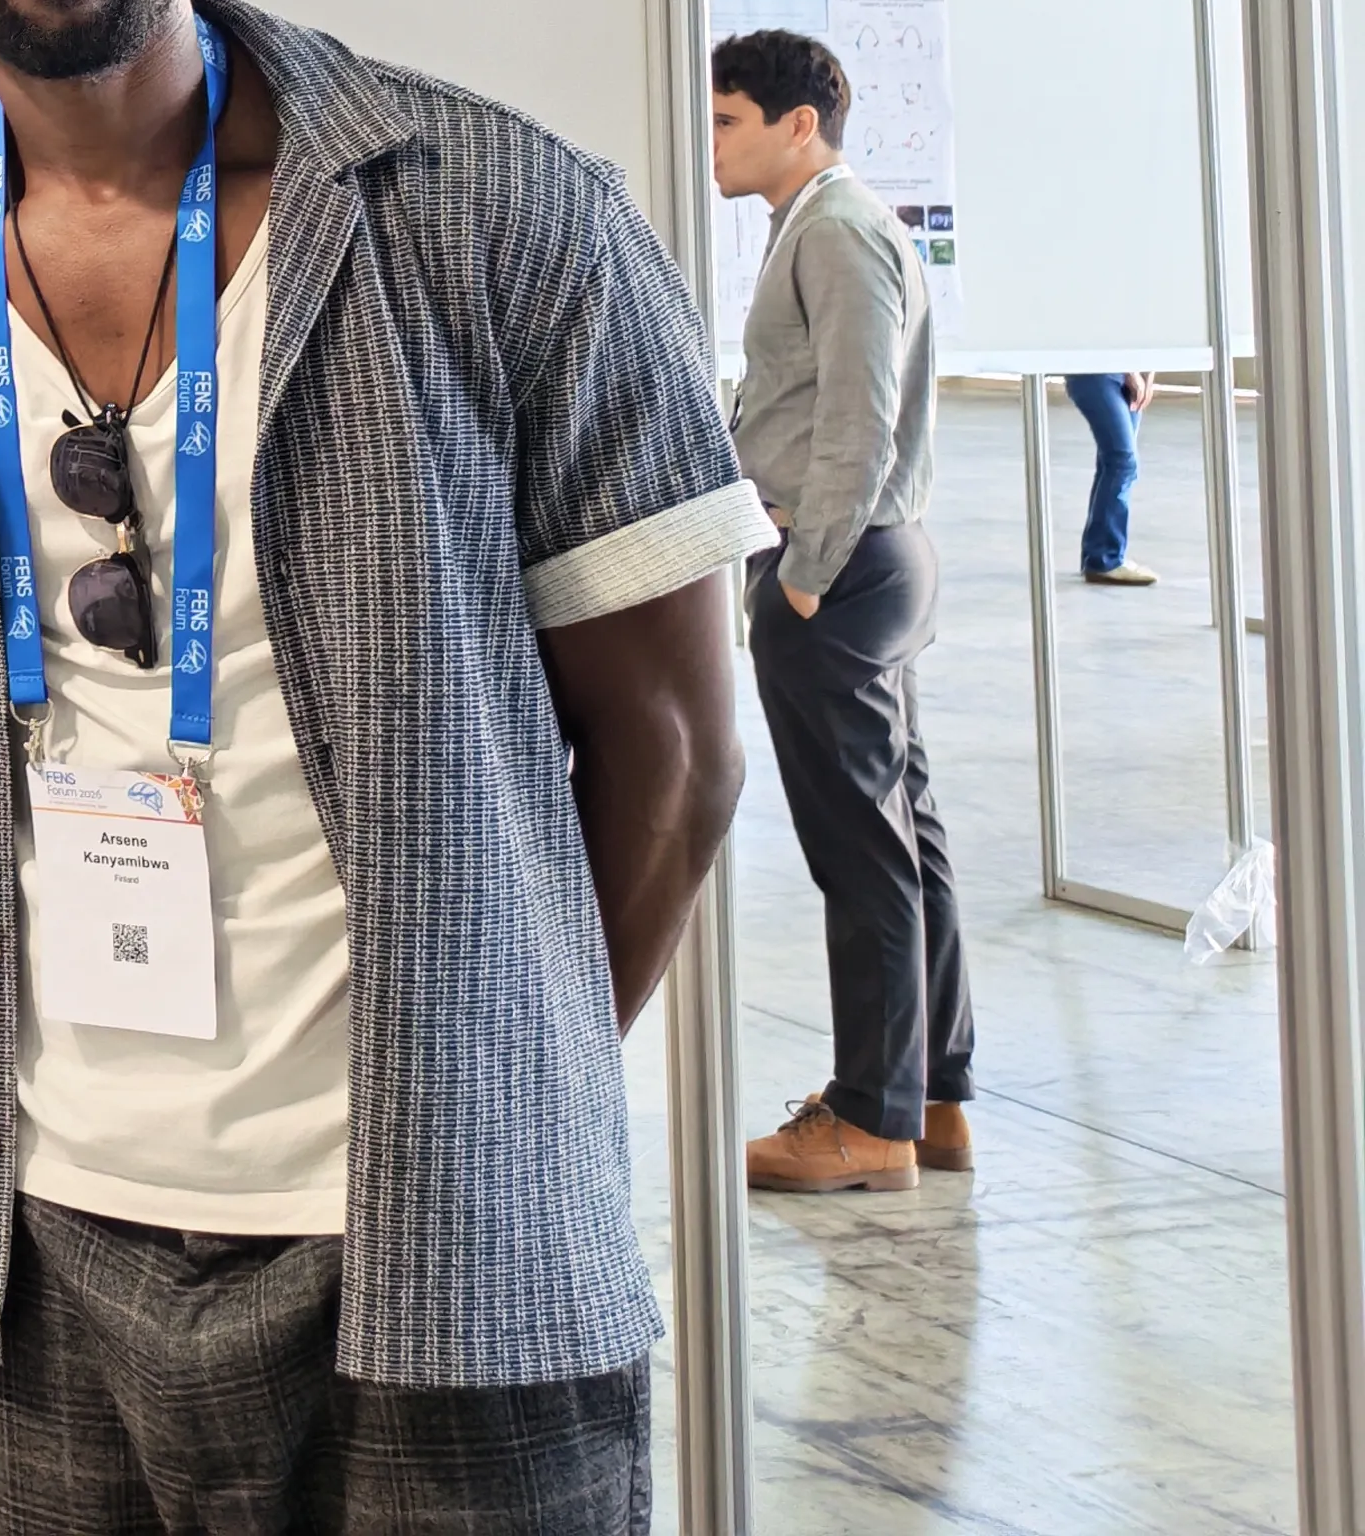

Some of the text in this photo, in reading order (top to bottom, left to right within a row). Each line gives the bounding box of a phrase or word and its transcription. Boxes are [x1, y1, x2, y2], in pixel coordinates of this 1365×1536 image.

[196, 164, 211, 201] FENS
[179, 372, 190, 412] Forum
[195, 372, 211, 413] FENS
[1, 557, 13, 598] Forum
[14, 556, 32, 597] FENS
[176, 588, 186, 630] Forum
[191, 590, 208, 632] FENS
[46, 771, 76, 785] FENS
[47, 785, 102, 799] Forum 2026
[101, 832, 148, 847] Arsene
[83, 852, 169, 870] Kanyamibwa
[114, 874, 139, 884] Finland
